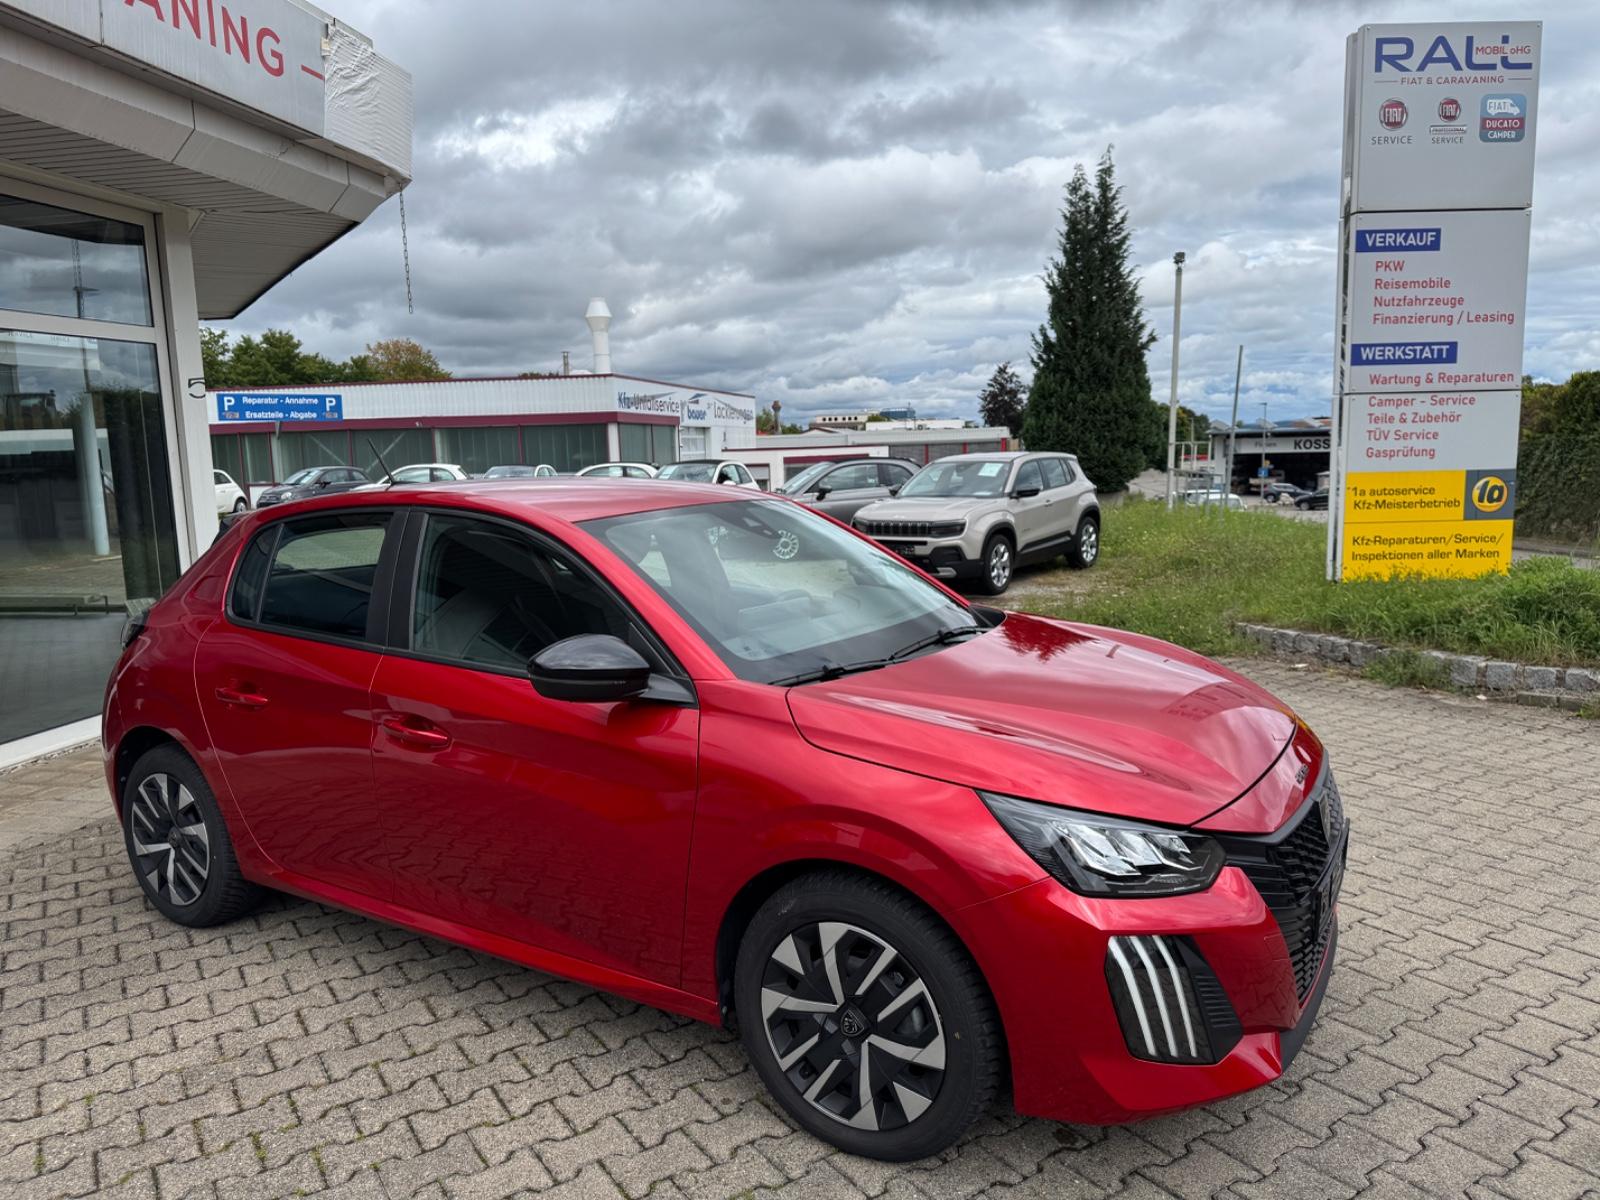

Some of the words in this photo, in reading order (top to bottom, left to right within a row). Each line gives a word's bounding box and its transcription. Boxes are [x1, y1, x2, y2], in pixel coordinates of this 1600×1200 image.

[1374, 34, 1533, 74] RALL
[1475, 45, 1508, 56] MOBIL
[1510, 45, 1532, 55] oHG
[1400, 77, 1424, 86] FIAT
[1426, 76, 1434, 85] &
[1436, 75, 1505, 86] CARAVANING
[1441, 104, 1457, 117] FIAT
[1488, 100, 1507, 112] FIAT
[1385, 108, 1402, 123] FIAT
[1486, 119, 1520, 129] DUCATO
[1371, 135, 1413, 145] SERVICE
[1431, 136, 1465, 144] SERVICE
[1487, 130, 1516, 139] CAMPER
[1365, 231, 1437, 248] VERKAUF
[1375, 260, 1405, 272] PKW
[1374, 276, 1452, 290] Reisemobile
[1373, 294, 1465, 308] Nutzfahrzeuge
[1372, 312, 1454, 326] Finanzierung
[1456, 310, 1465, 325] /
[1466, 311, 1515, 325] Leasing
[1360, 344, 1450, 361] WERKSTATT
[1369, 373, 1421, 387] Wartung
[1425, 373, 1434, 384] &
[1437, 371, 1515, 386] Reparaturen
[223, 396, 236, 411] P
[242, 396, 279, 405] Reparatur
[285, 396, 319, 405] Annahme
[325, 397, 336, 411] P
[1368, 395, 1416, 409] Camper
[1430, 394, 1476, 406] Service
[244, 410, 284, 419] Ersatzteile
[290, 410, 318, 420] Abgabe
[1367, 412, 1395, 424] Teile
[1398, 412, 1407, 424] &
[1411, 411, 1462, 424] Zubehör
[1366, 428, 1390, 441] TÜV
[1393, 429, 1440, 441] Service
[1365, 446, 1436, 461] Gasprüfung
[1351, 486, 1366, 497] 1a
[1368, 485, 1436, 497] autoservice
[1477, 480, 1505, 504] 1a
[1353, 497, 1461, 511] Kfz-Meisterbetrieb
[1351, 550, 1424, 563] Inspektionen
[1426, 549, 1453, 560] aller
[1455, 548, 1500, 560] Marken
